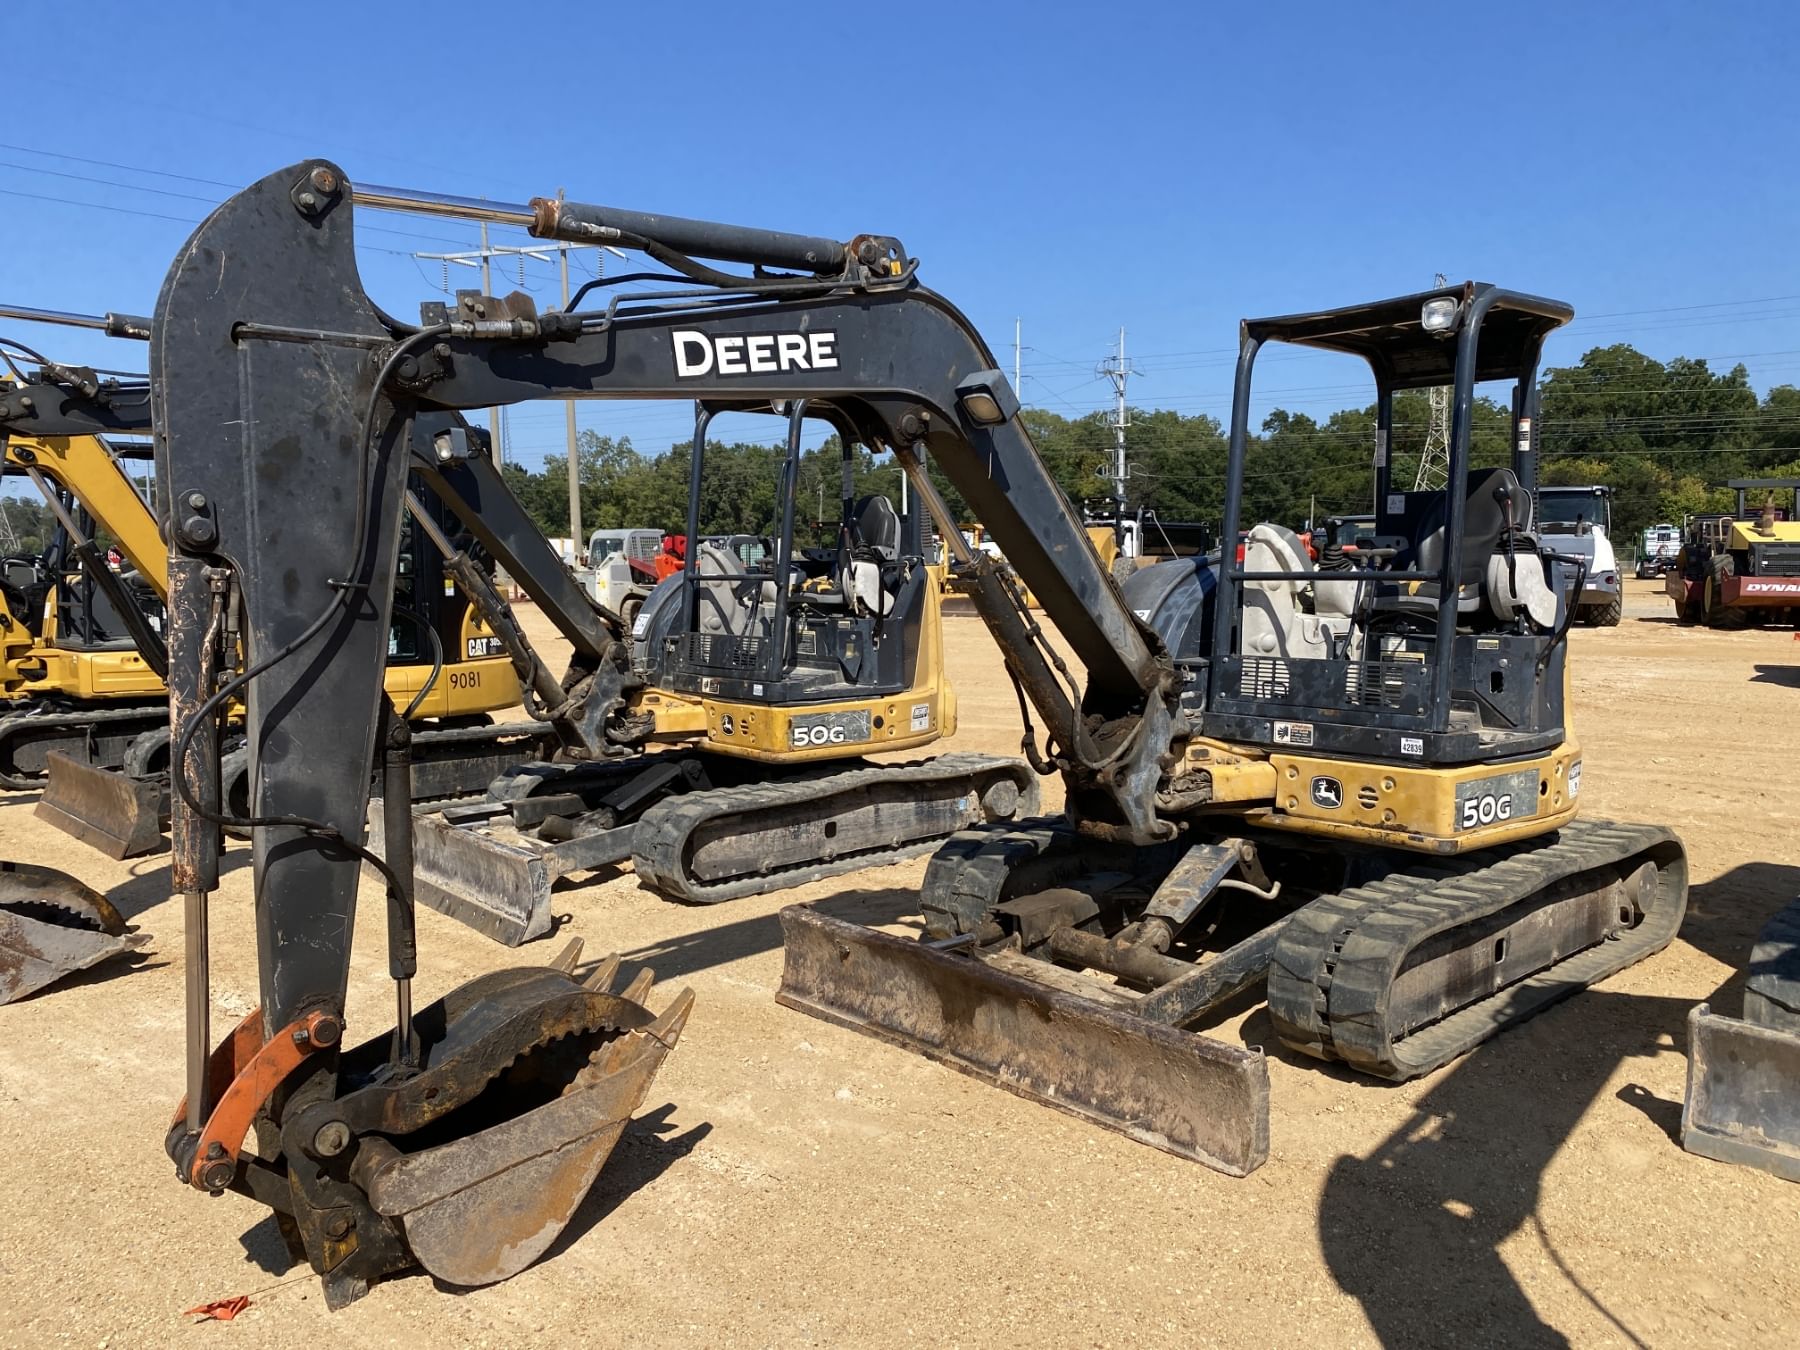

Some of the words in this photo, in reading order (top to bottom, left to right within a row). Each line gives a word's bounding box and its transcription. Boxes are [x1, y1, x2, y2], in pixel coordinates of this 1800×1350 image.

[672, 330, 838, 377] DEERE
[468, 638, 488, 656] CAT
[450, 672, 481, 689] 9081
[793, 725, 845, 747] 50G
[1462, 794, 1512, 828] 50G
